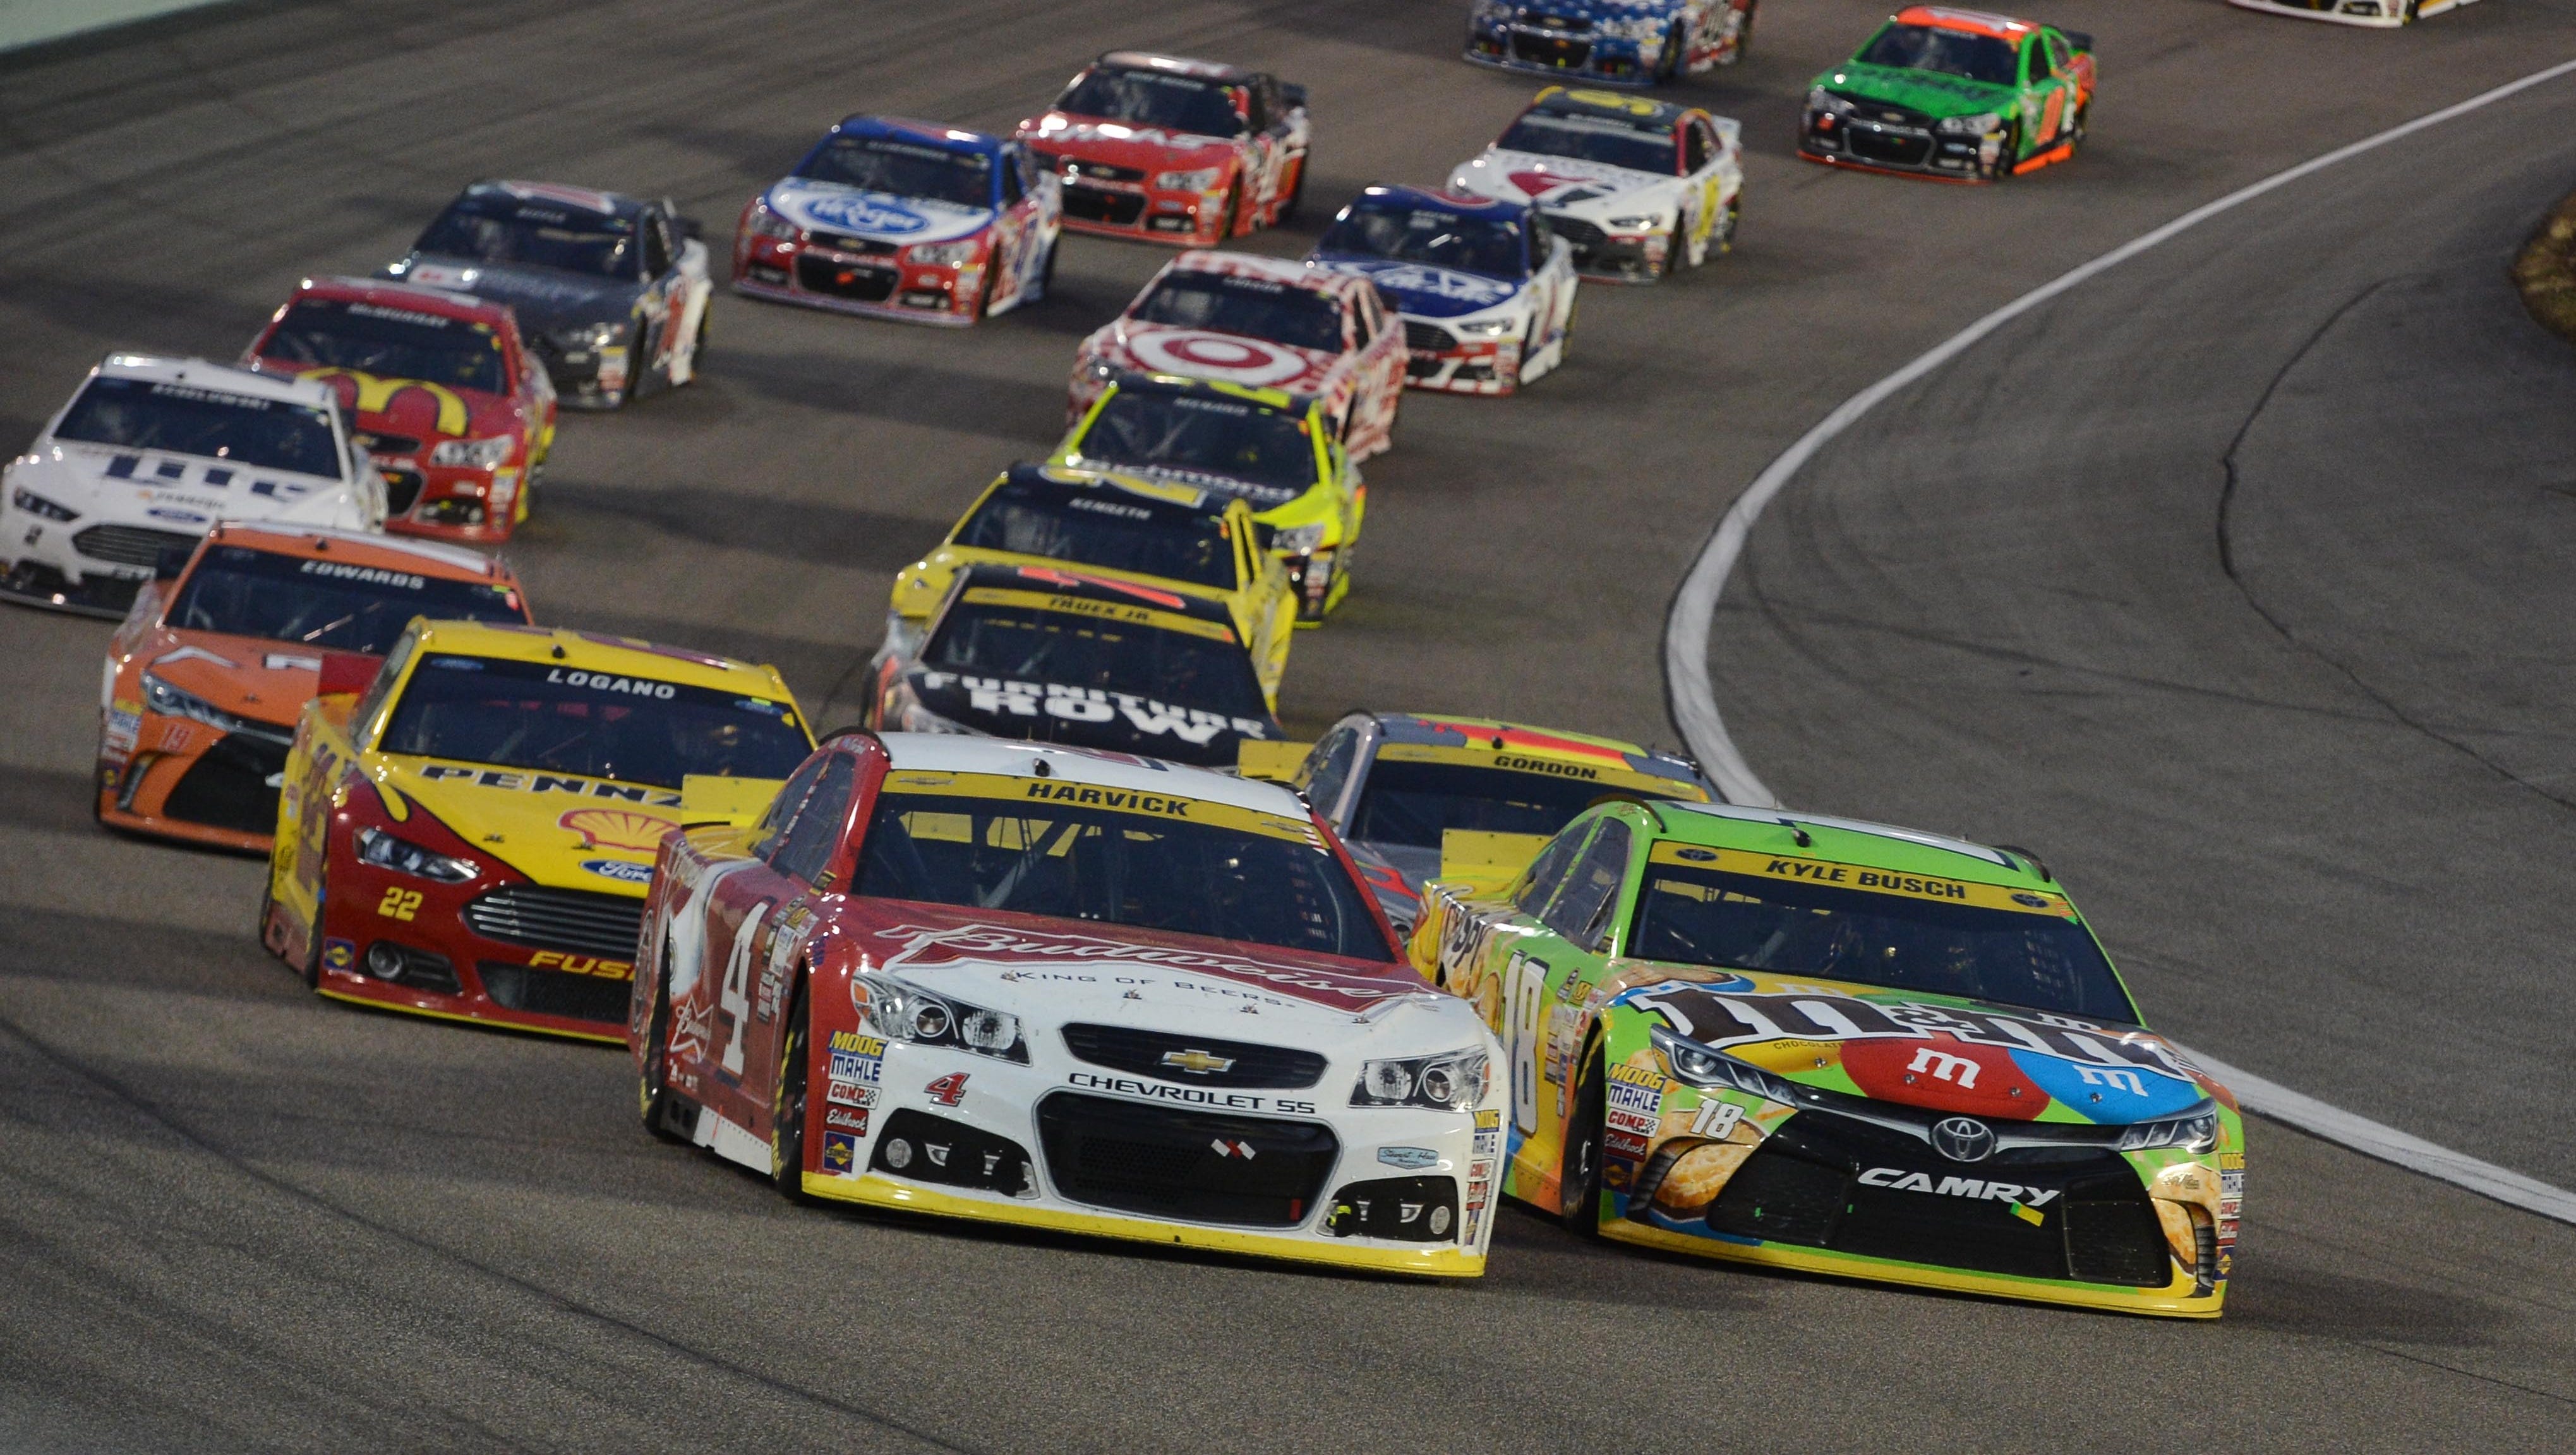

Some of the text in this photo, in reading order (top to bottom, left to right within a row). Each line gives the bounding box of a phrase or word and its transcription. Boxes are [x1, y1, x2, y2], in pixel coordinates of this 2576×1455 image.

[1069, 497, 1153, 520] KENSETH
[301, 560, 426, 590] EDWARDS
[1049, 596, 1116, 616] TRUEX
[547, 668, 677, 700] LOGANO
[923, 671, 1266, 741] FURNITURE
[970, 688, 1220, 745] ROW
[1494, 756, 1597, 779] GORDON
[1027, 782, 1190, 817] HARVICK
[1766, 859, 1966, 899] KYLE BUSCH
[378, 887, 424, 922] 22
[529, 950, 636, 981] FUS
[1016, 971, 1097, 984] KING
[1116, 976, 1157, 985] OF
[720, 901, 770, 1076] 4
[830, 1031, 886, 1058] MOOG
[1502, 949, 1550, 1135] 18
[831, 1055, 882, 1082] MAHLE
[1610, 1064, 1665, 1090] MOOG
[1907, 1047, 1981, 1089] m
[2073, 1065, 2148, 1098] m
[831, 1084, 866, 1101] COMP
[924, 1072, 971, 1108] 4
[1068, 1072, 1316, 1114] CHEVROLET SS
[1608, 1085, 1661, 1113] MAHLE
[1608, 1110, 1646, 1129] COMP
[1689, 1098, 1747, 1140] 18
[1858, 1168, 2061, 1207] CAMRY
